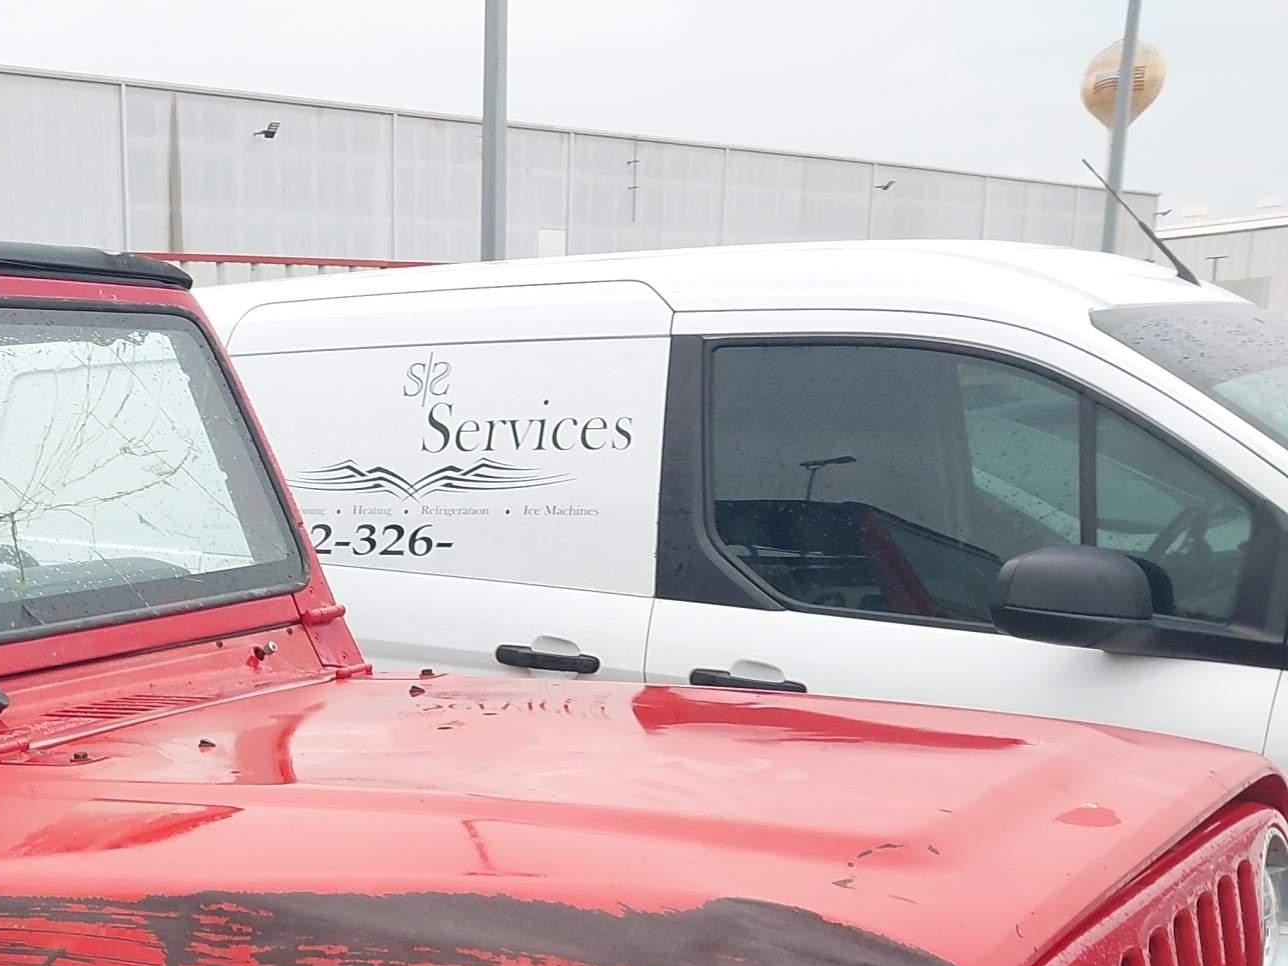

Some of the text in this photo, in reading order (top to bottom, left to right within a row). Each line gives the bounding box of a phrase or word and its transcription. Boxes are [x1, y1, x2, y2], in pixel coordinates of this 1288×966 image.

[421, 399, 633, 453] Services
[421, 505, 489, 516] Refrigeration
[523, 505, 539, 515] Ice
[545, 505, 600, 516] Machines
